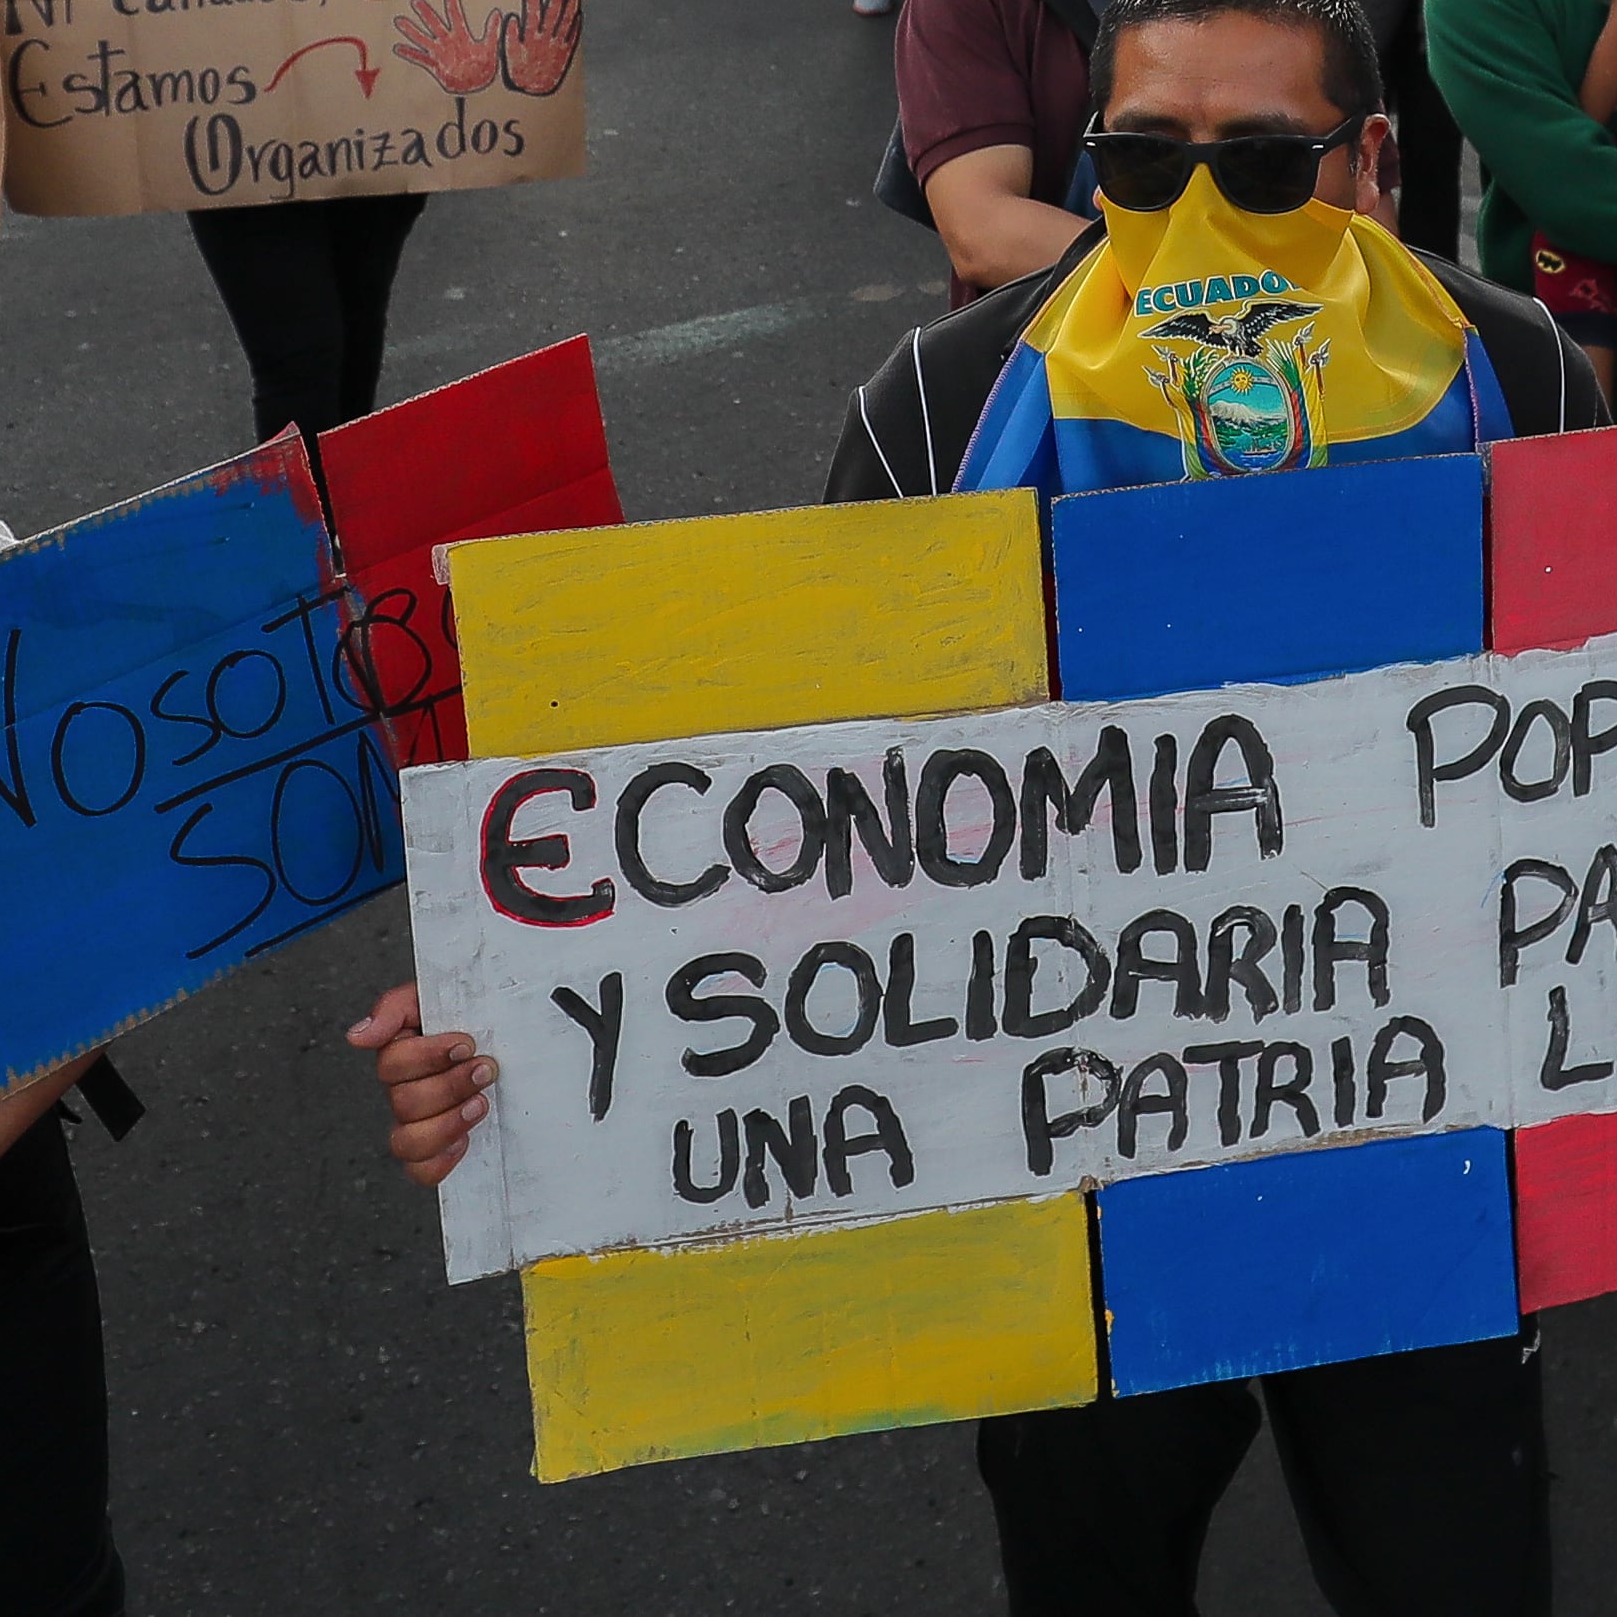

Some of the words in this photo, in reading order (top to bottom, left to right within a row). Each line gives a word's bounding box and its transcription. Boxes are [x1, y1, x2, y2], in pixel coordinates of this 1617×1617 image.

[10, 37, 257, 129] Estamos
[183, 97, 525, 204] Organizados
[1134, 268, 1303, 318] ECUADO
[479, 711, 1285, 928] ECONOMIA
[548, 970, 625, 1124] Y
[666, 884, 1392, 1079] SOLIDARIA
[670, 1082, 917, 1210] UNA
[1020, 1015, 1447, 1177] PATRIA
